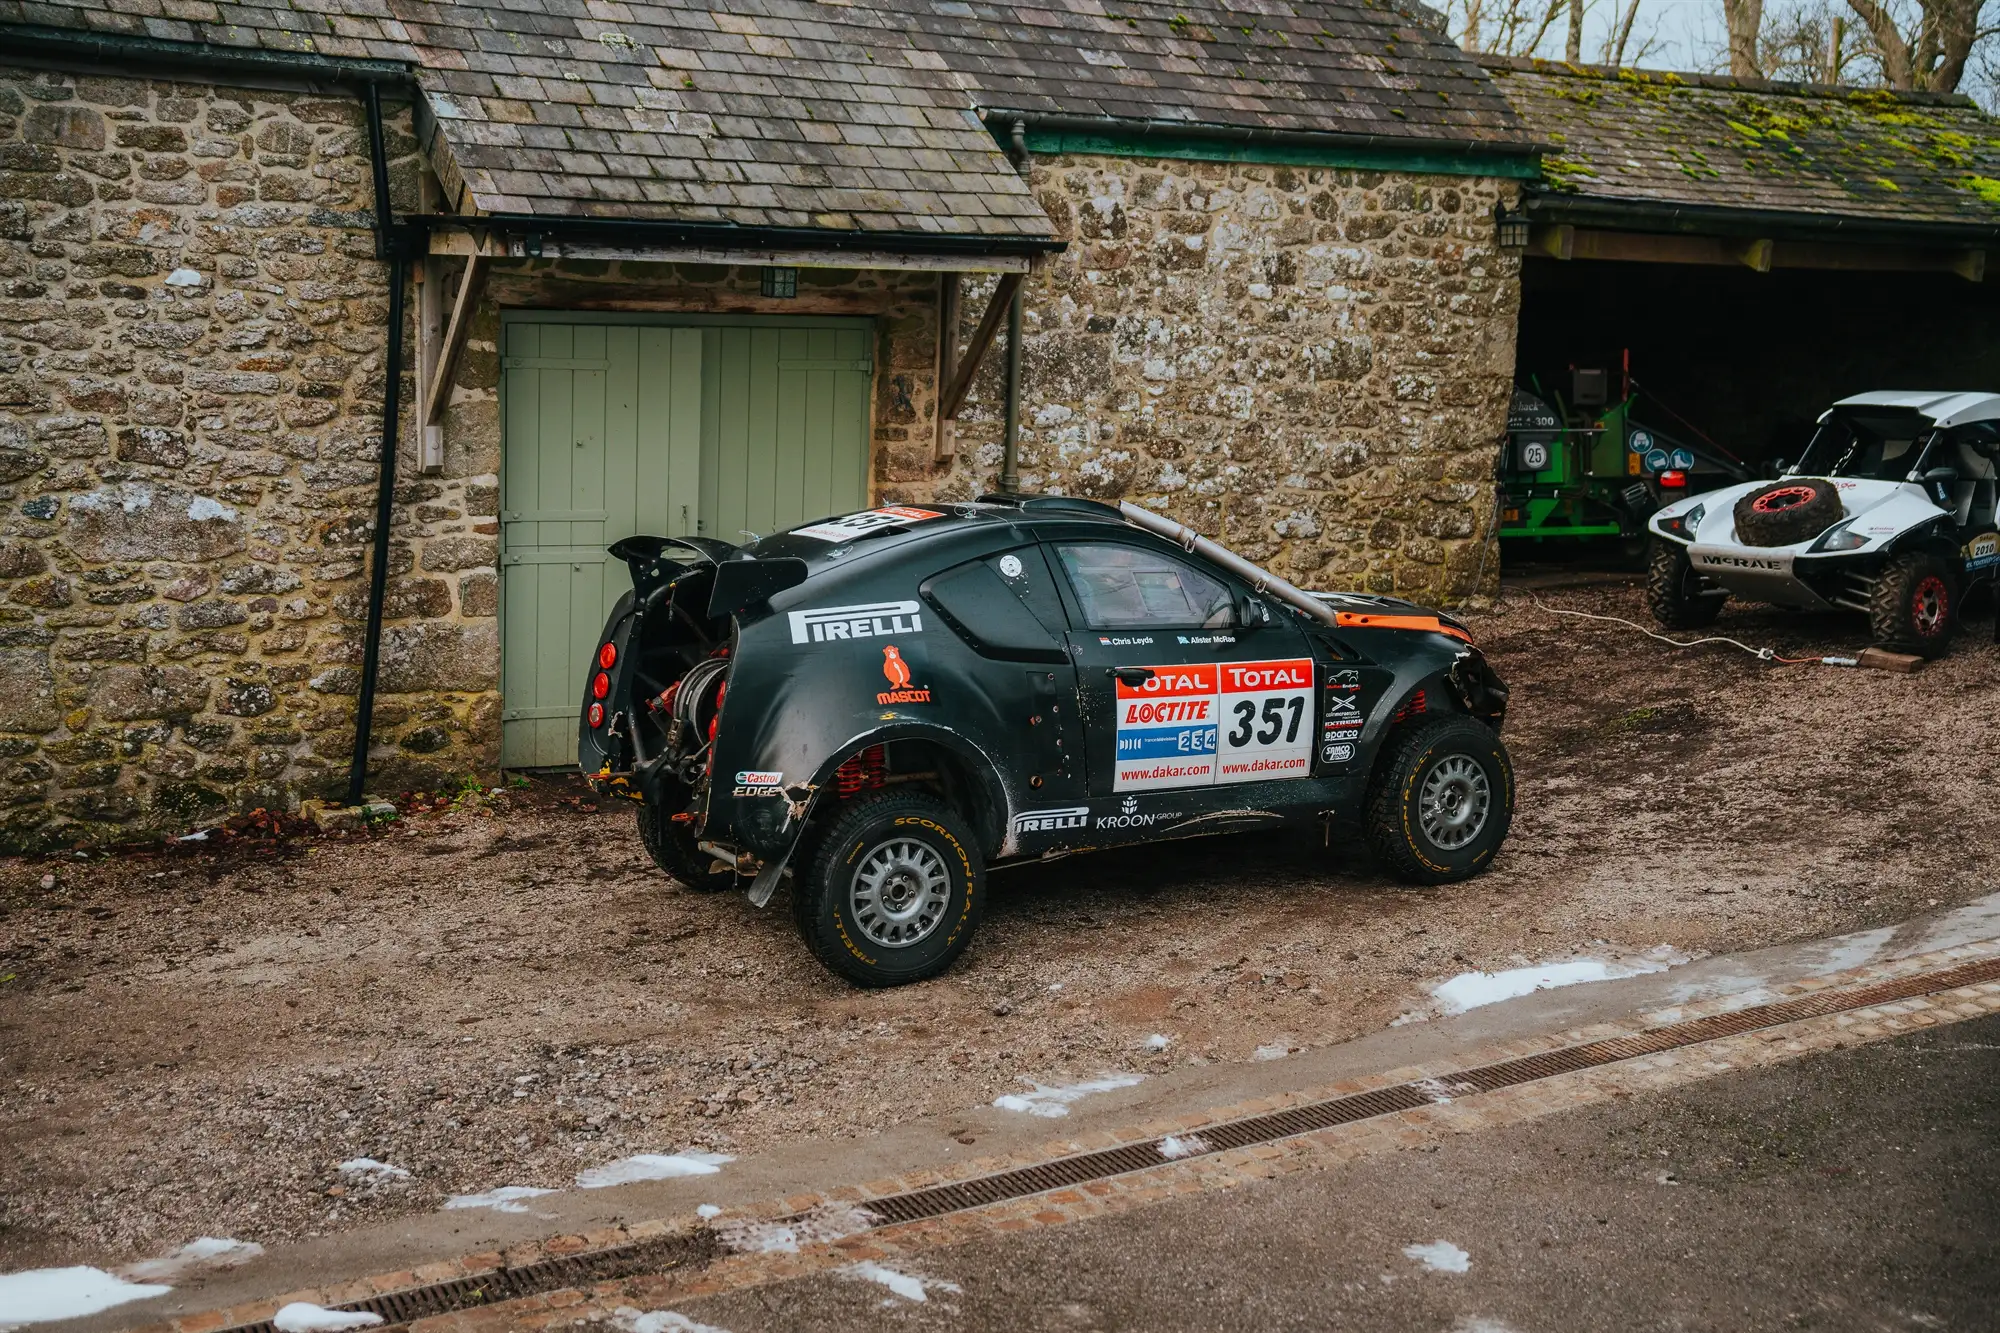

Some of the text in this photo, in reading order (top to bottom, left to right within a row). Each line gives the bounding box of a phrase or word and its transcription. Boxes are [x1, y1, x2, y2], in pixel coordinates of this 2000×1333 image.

[1528, 447, 1542, 463] 25
[1975, 543, 1995, 556] 2010
[787, 600, 923, 645] PIRELLI
[1112, 636, 1154, 646] Chris Leyds
[1190, 635, 1236, 645] Alister McRae
[1228, 668, 1305, 687] TOTAL
[876, 690, 930, 705] MASCOT
[1125, 700, 1210, 724] LOCTITE
[1228, 696, 1305, 748] 351
[1325, 729, 1358, 741] sparco
[1326, 745, 1351, 755] SAMCO
[1121, 764, 1210, 781] www.dakar.com
[1222, 757, 1306, 775] www.dakar.com
[747, 773, 778, 783] Castrol
[732, 786, 777, 797] EDGE
[1012, 806, 1090, 833] PIRELLI
[894, 817, 974, 878] SCORPION
